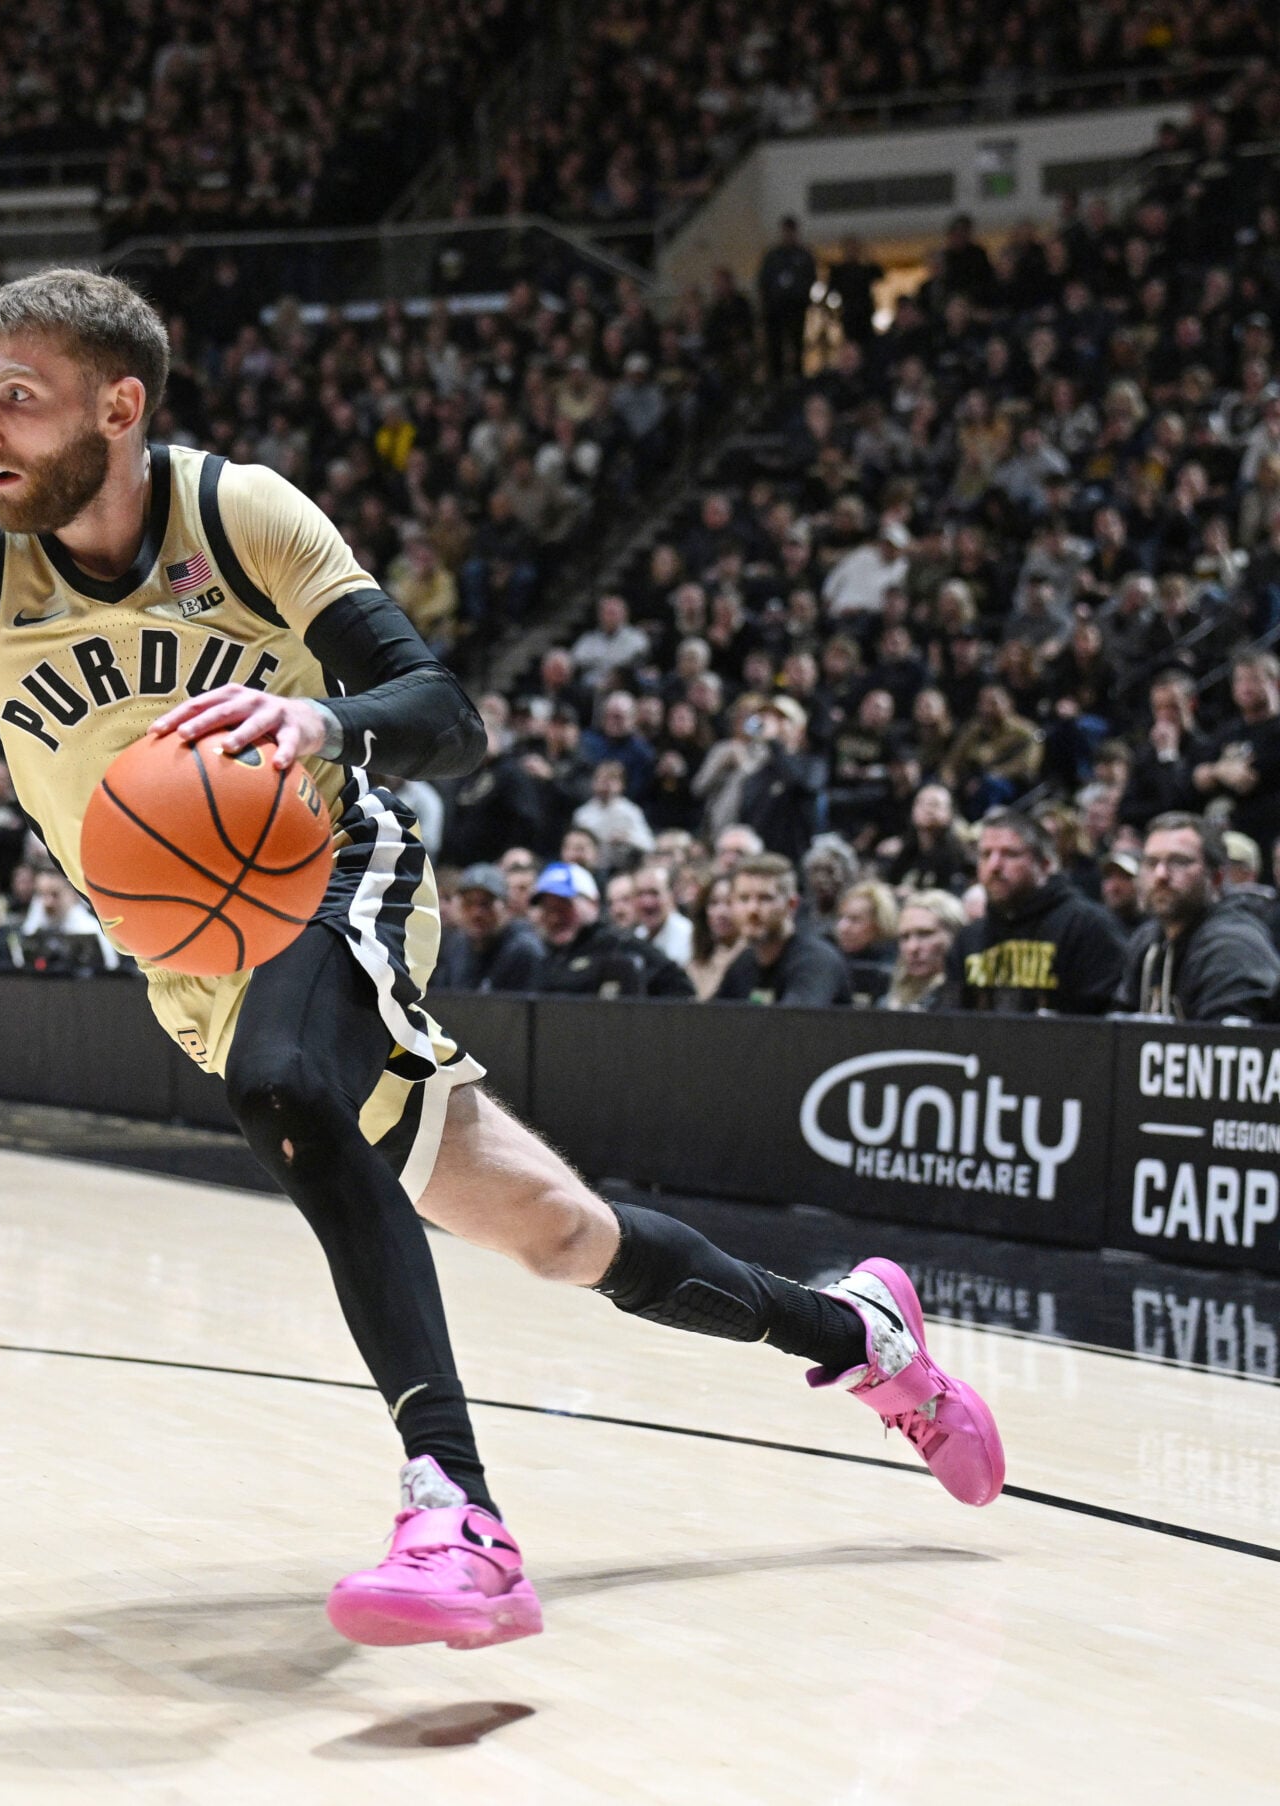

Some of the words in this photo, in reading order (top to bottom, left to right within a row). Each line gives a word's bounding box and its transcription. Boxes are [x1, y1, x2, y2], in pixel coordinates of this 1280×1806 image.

[178, 586, 225, 618] BIG
[1, 627, 281, 754] PURDUE
[854, 1145, 1032, 1198] HEALTHCARE
